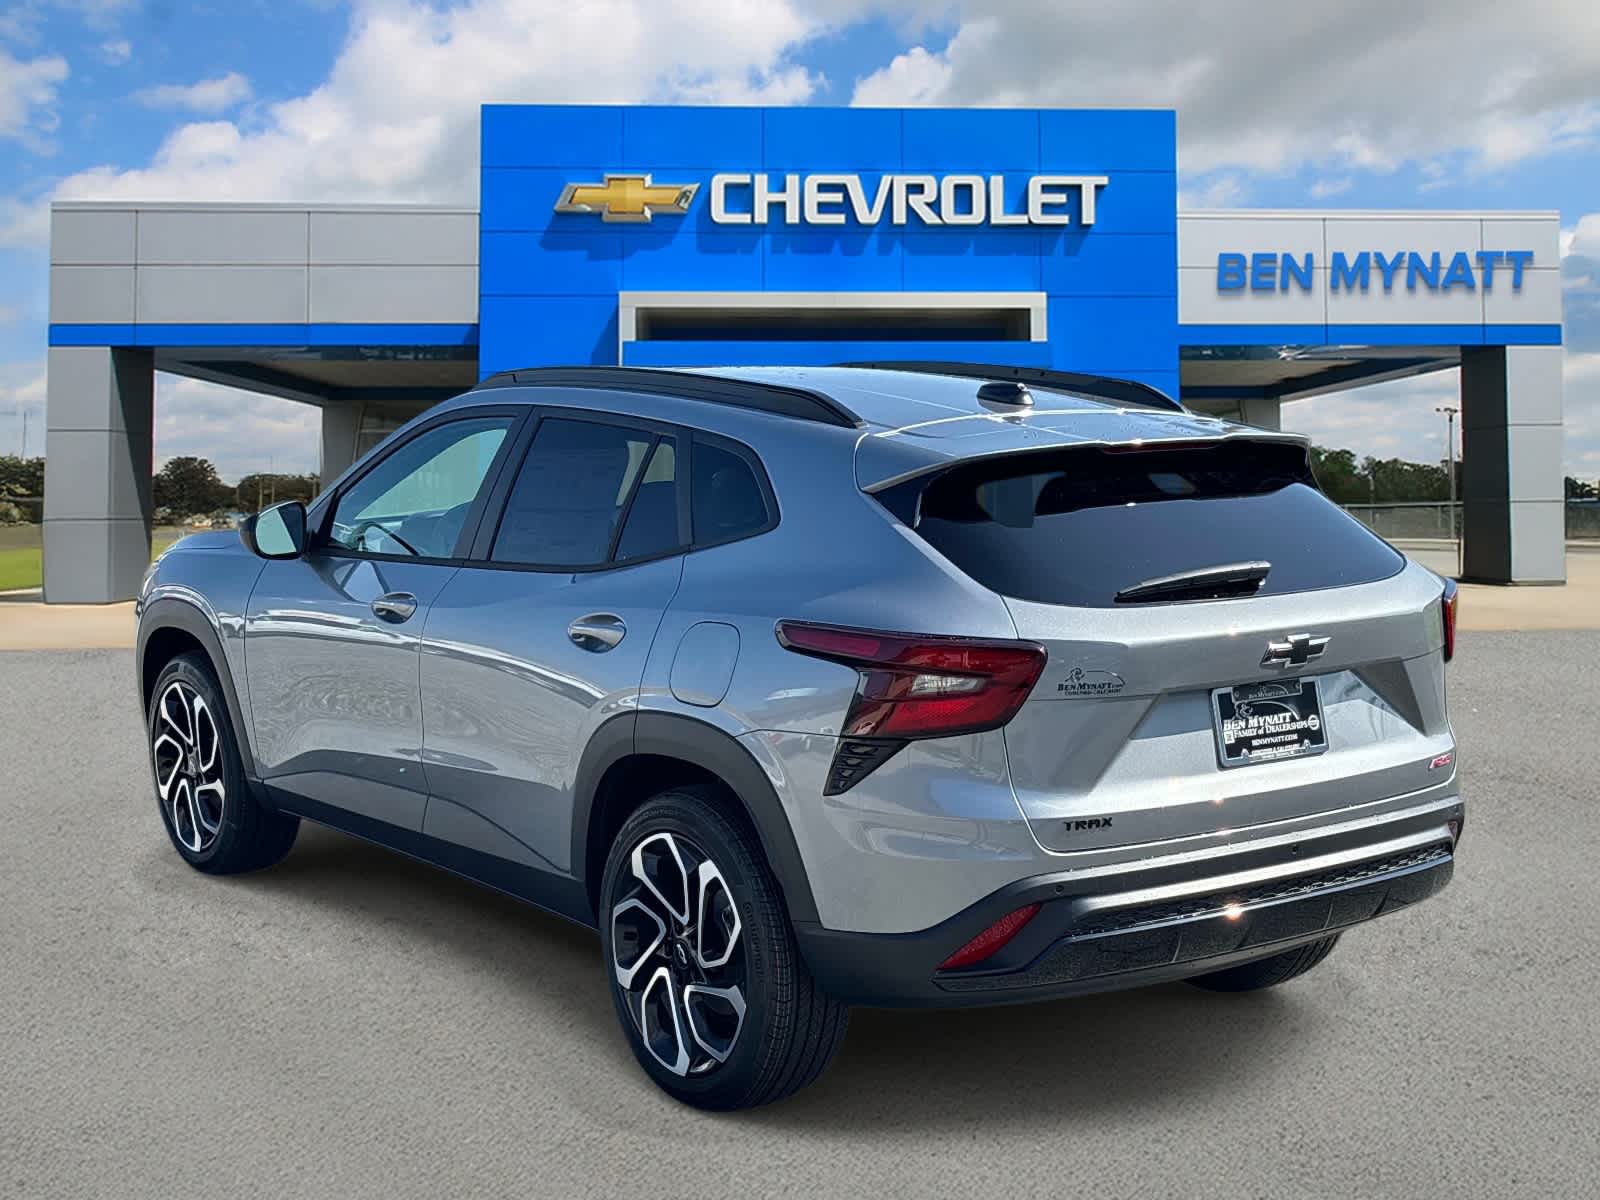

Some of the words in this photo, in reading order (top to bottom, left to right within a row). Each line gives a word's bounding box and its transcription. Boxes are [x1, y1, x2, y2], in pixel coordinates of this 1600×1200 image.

[710, 174, 1109, 225] CHEVROLET
[1217, 252, 1314, 291] BEN
[1330, 250, 1534, 291] MYNATT
[1223, 719, 1246, 732] BEN
[1247, 711, 1292, 729] MYNATT
[1233, 727, 1258, 739] FAMILY
[1265, 720, 1308, 734] DEALERSHIPS
[1063, 816, 1113, 831] TRAX
